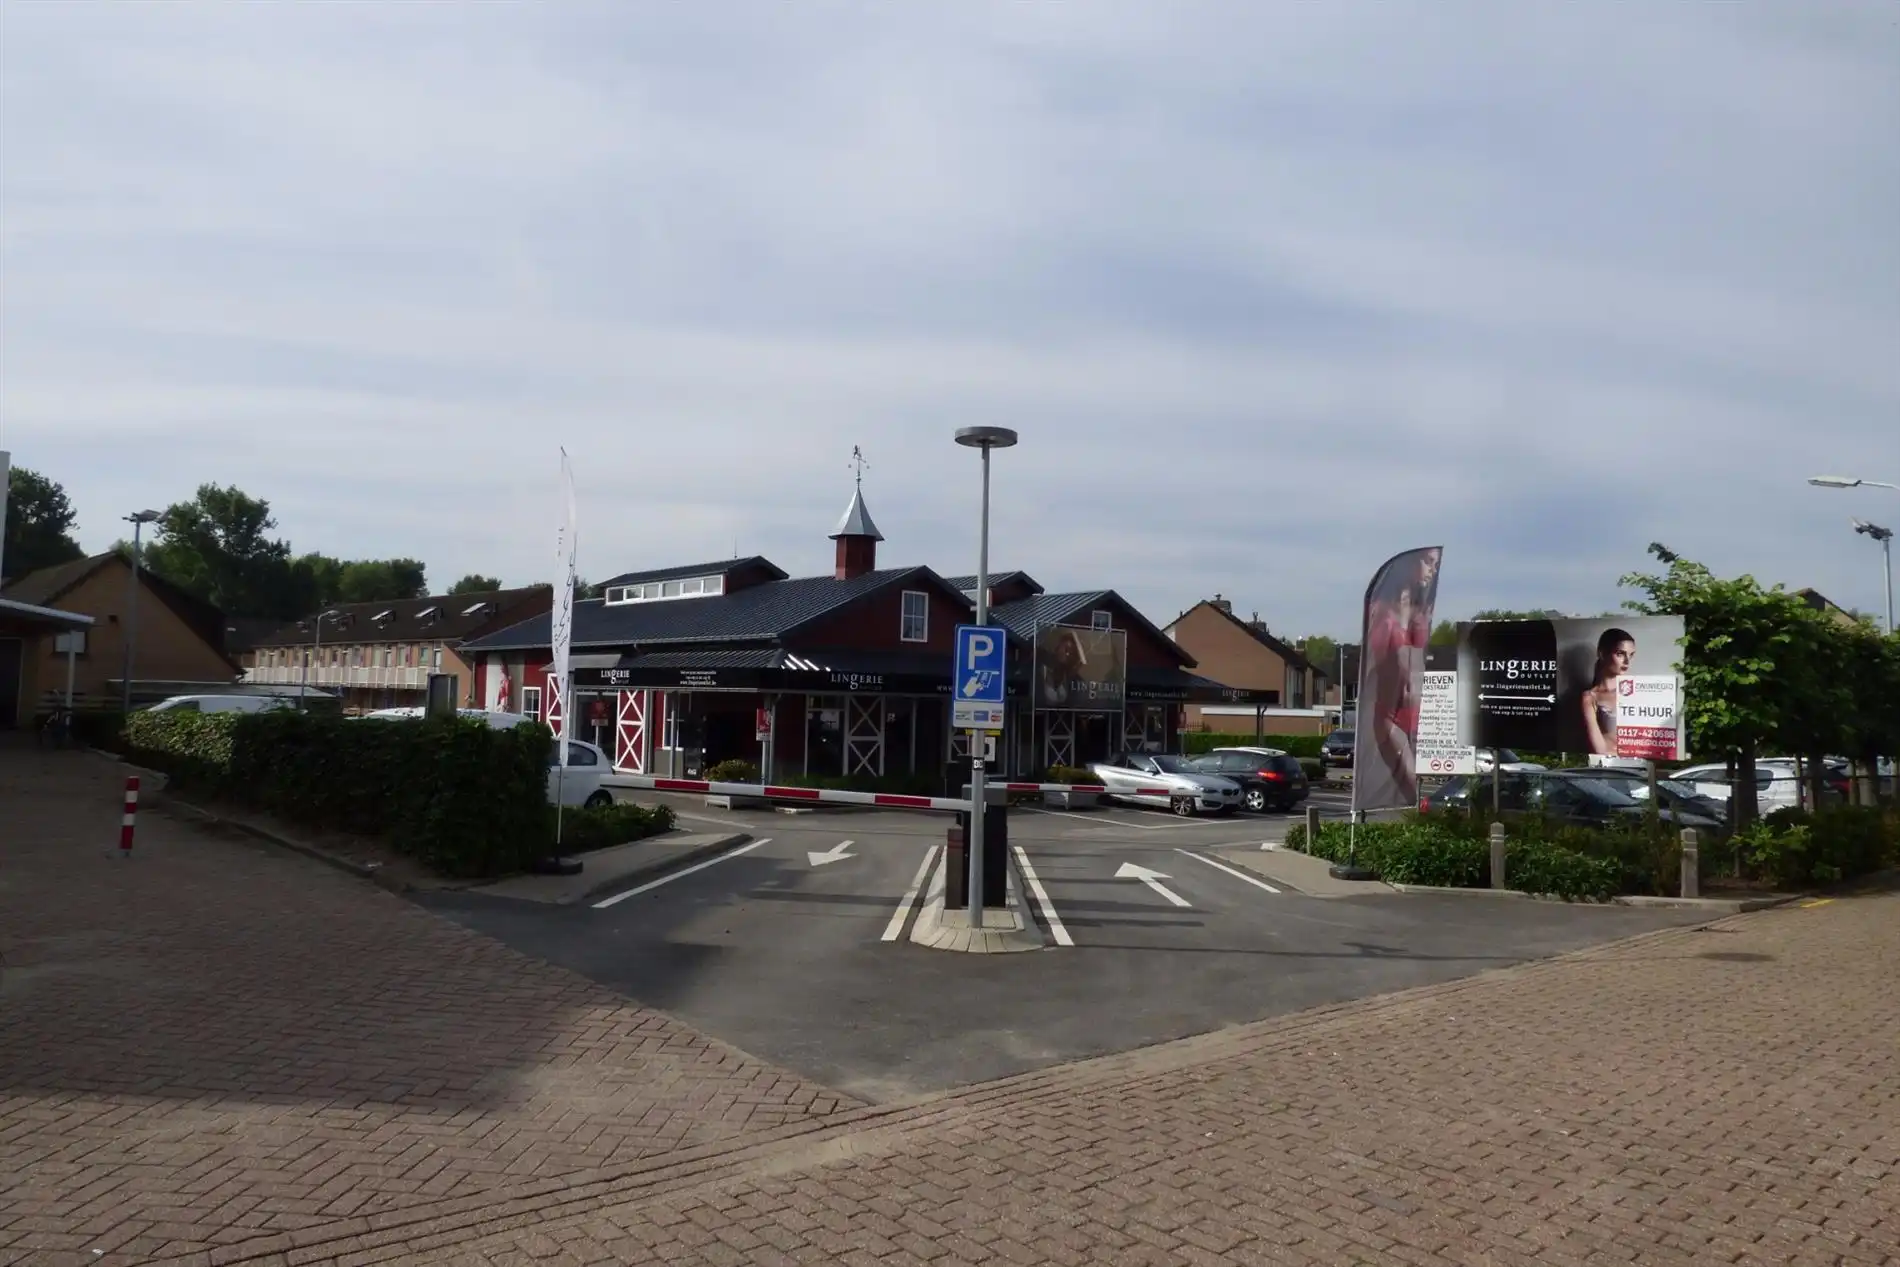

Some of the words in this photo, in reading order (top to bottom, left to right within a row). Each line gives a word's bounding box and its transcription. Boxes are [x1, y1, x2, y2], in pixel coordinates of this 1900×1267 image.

[967, 634, 993, 670] P
[1621, 706, 1635, 716] TE
[1639, 706, 1673, 718] HUUR
